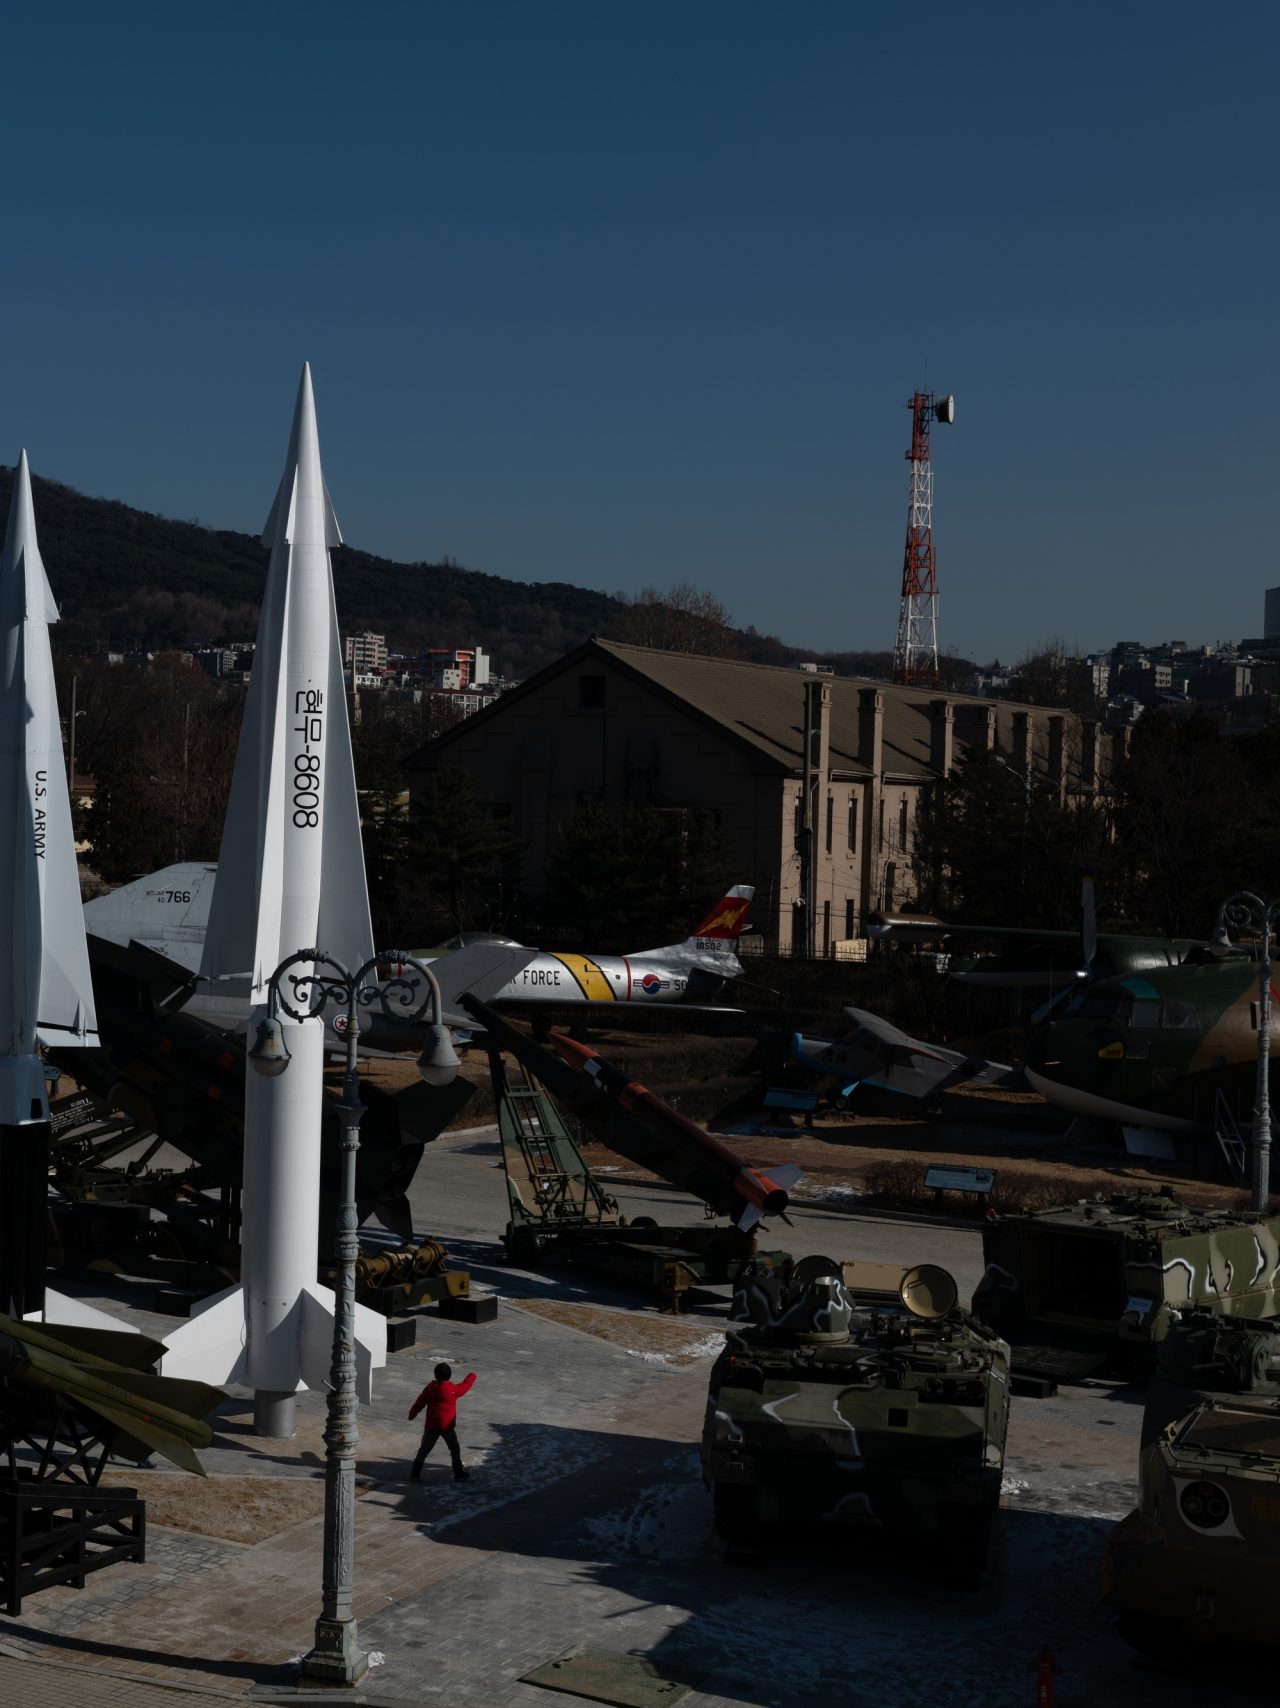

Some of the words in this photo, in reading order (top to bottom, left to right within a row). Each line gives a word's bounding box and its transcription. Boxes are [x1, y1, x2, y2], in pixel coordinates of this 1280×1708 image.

[293, 689, 323, 829] 현무-8608
[35, 770, 47, 801] U.S.
[34, 808, 46, 859] ARMY
[165, 890, 191, 903] 766
[523, 969, 561, 986] FORCE
[674, 979, 695, 991] 502
